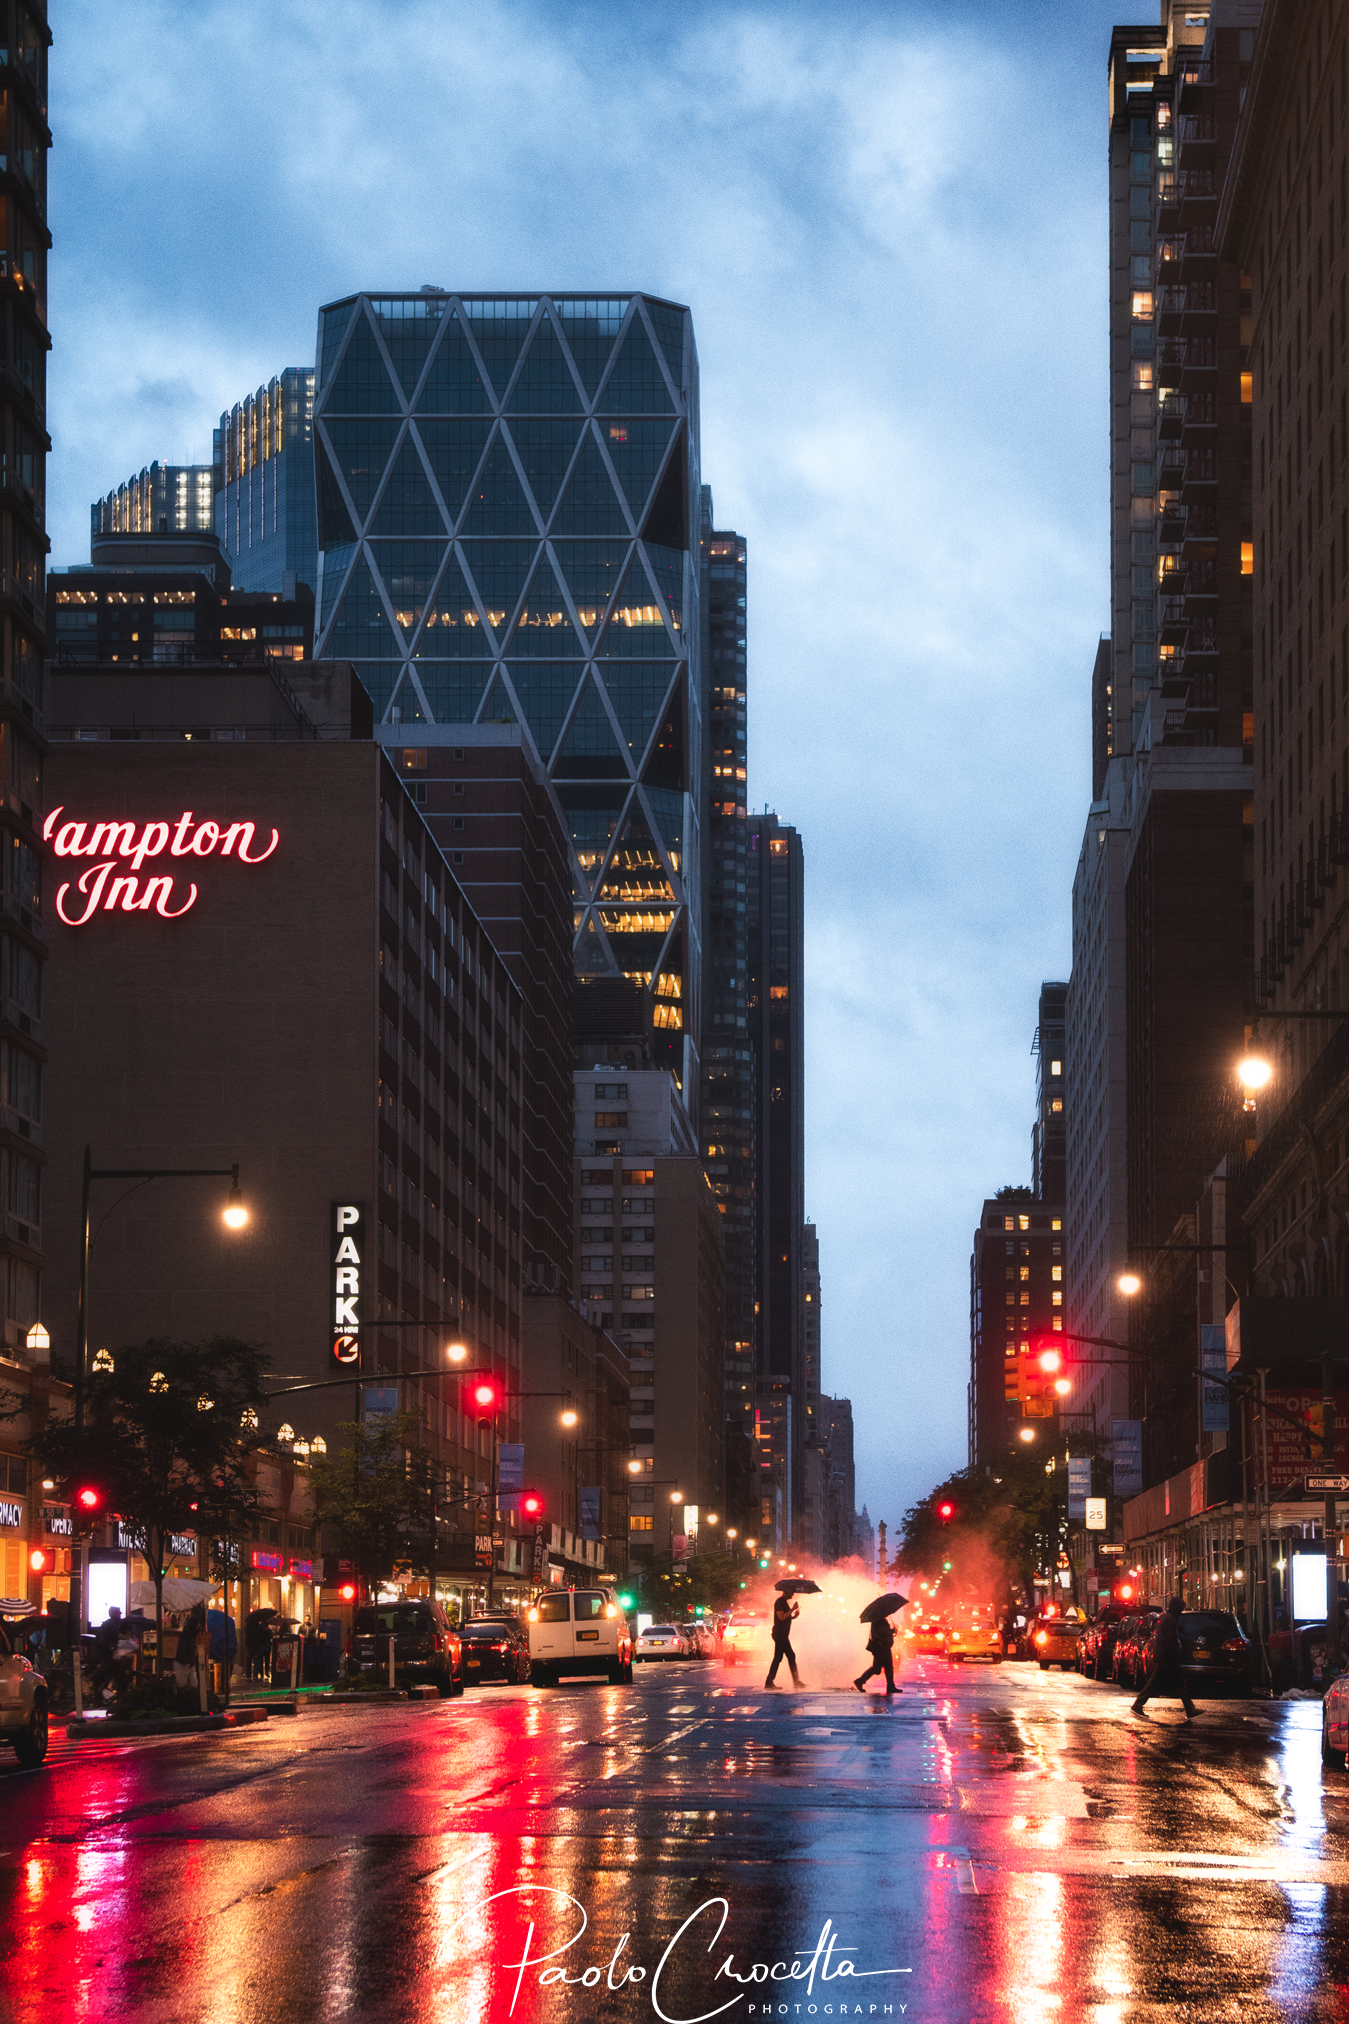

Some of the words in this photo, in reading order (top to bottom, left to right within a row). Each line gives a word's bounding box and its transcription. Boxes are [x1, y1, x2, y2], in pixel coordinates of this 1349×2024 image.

[56, 861, 198, 926] Inn
[334, 1206, 361, 1325] PARK
[333, 1326, 344, 1334] 24
[1203, 1347, 1226, 1355] WINN
[1204, 1394, 1229, 1402] HANS
[1273, 1432, 1303, 1442] HAPPY
[1271, 1466, 1293, 1474] FREE
[38, 1508, 45, 1517] W
[46, 1508, 55, 1518] 50
[1089, 1510, 1104, 1520] 25
[475, 1535, 493, 1552] PARK
[533, 1524, 544, 1566] PARK
